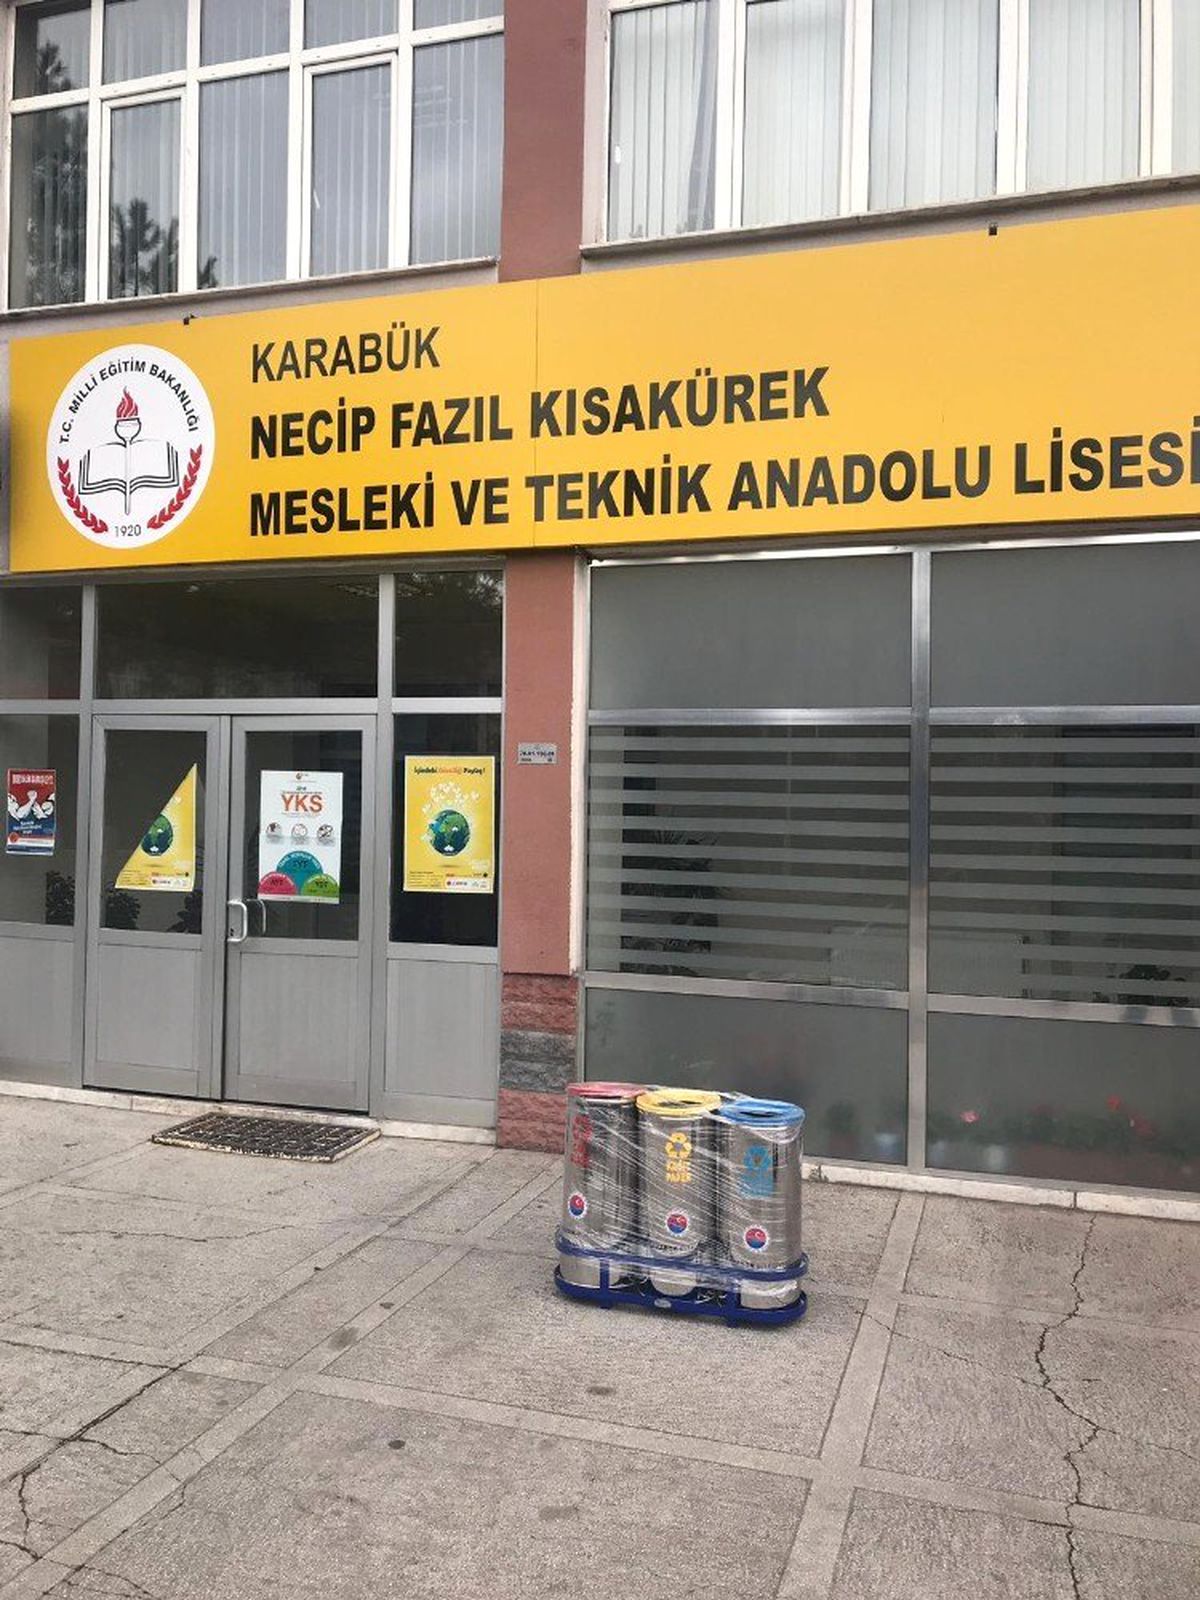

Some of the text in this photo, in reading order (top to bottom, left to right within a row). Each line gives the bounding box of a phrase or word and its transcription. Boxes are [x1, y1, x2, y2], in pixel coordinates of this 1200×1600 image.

[252, 322, 440, 384] KARABÜK
[59, 356, 199, 445] T.C. MİLLİ EĞİTİM BAKANLIĞI
[251, 366, 830, 460] NECİP FAZIL KISAKÜREK
[250, 415, 1200, 537] MESLEKİ VE TEKNİK ANADOLU LİSESİ
[114, 524, 142, 538] 1920
[281, 794, 323, 813] YKS
